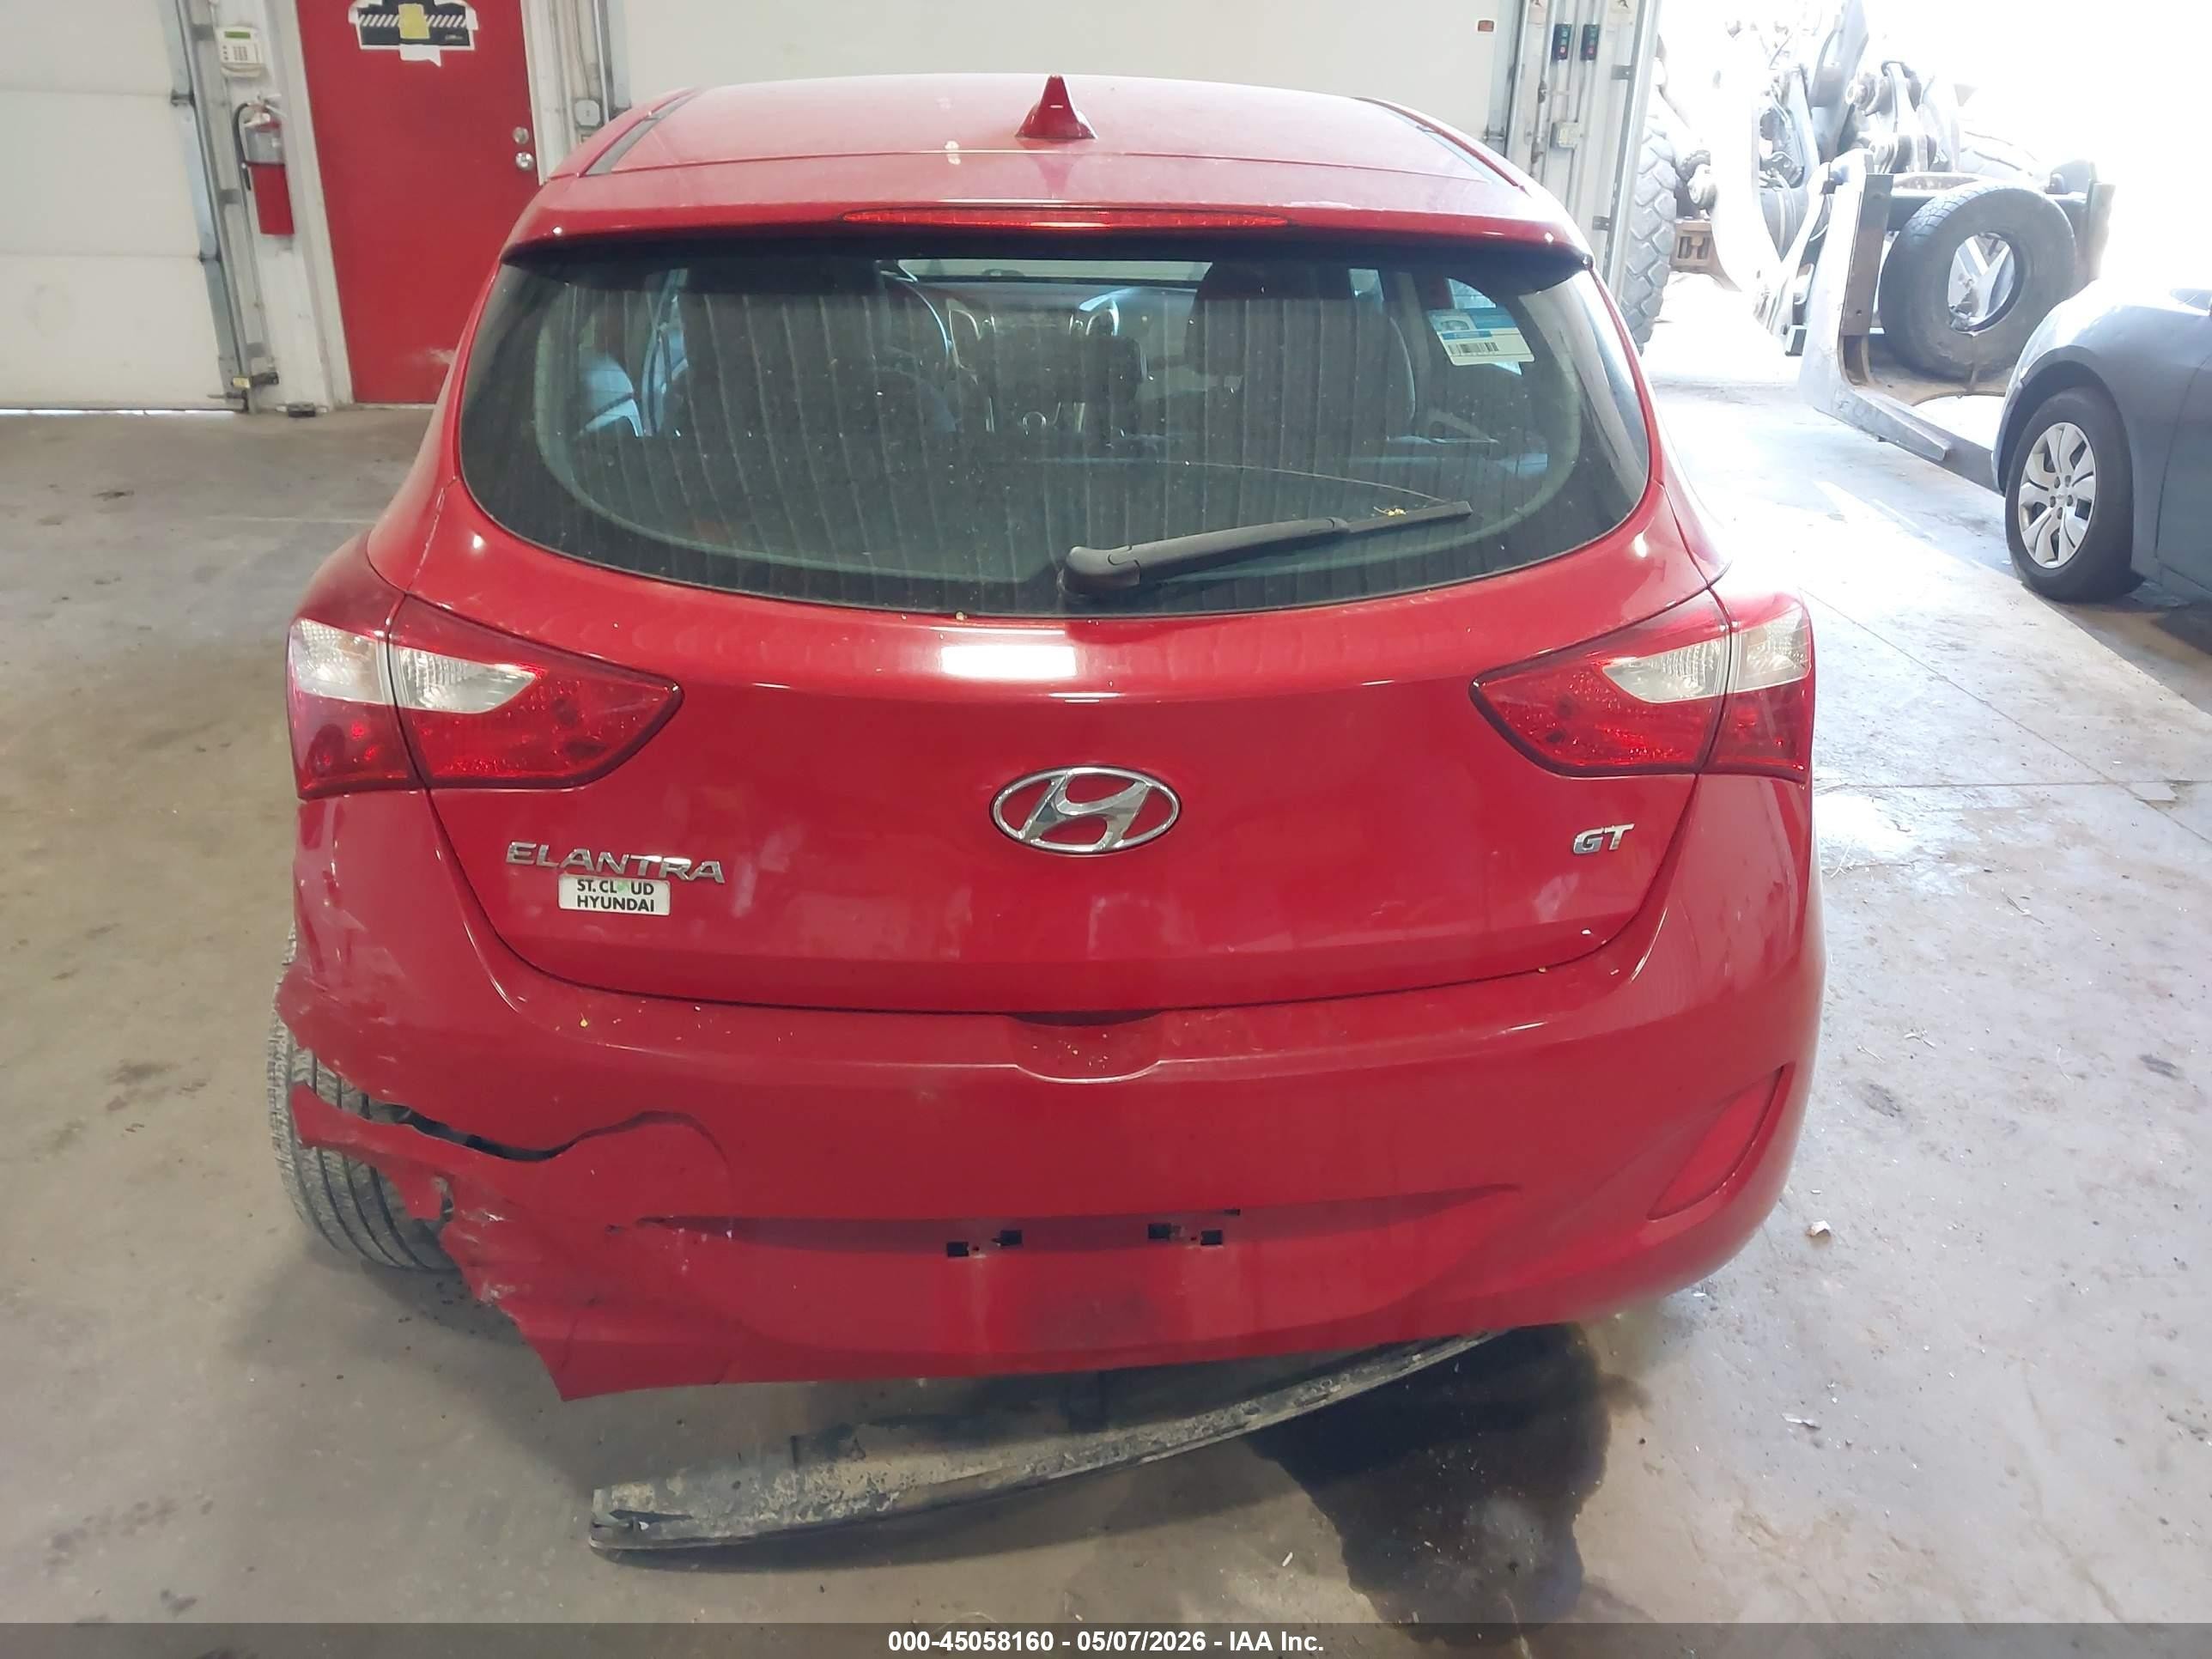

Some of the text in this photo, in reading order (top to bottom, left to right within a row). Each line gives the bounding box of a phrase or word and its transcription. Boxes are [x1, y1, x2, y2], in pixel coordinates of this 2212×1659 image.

[1573, 823, 1635, 854] GT
[505, 842, 725, 884] ELANTRA
[577, 878, 597, 893] ST.
[577, 896, 654, 912] HYUNDAI
